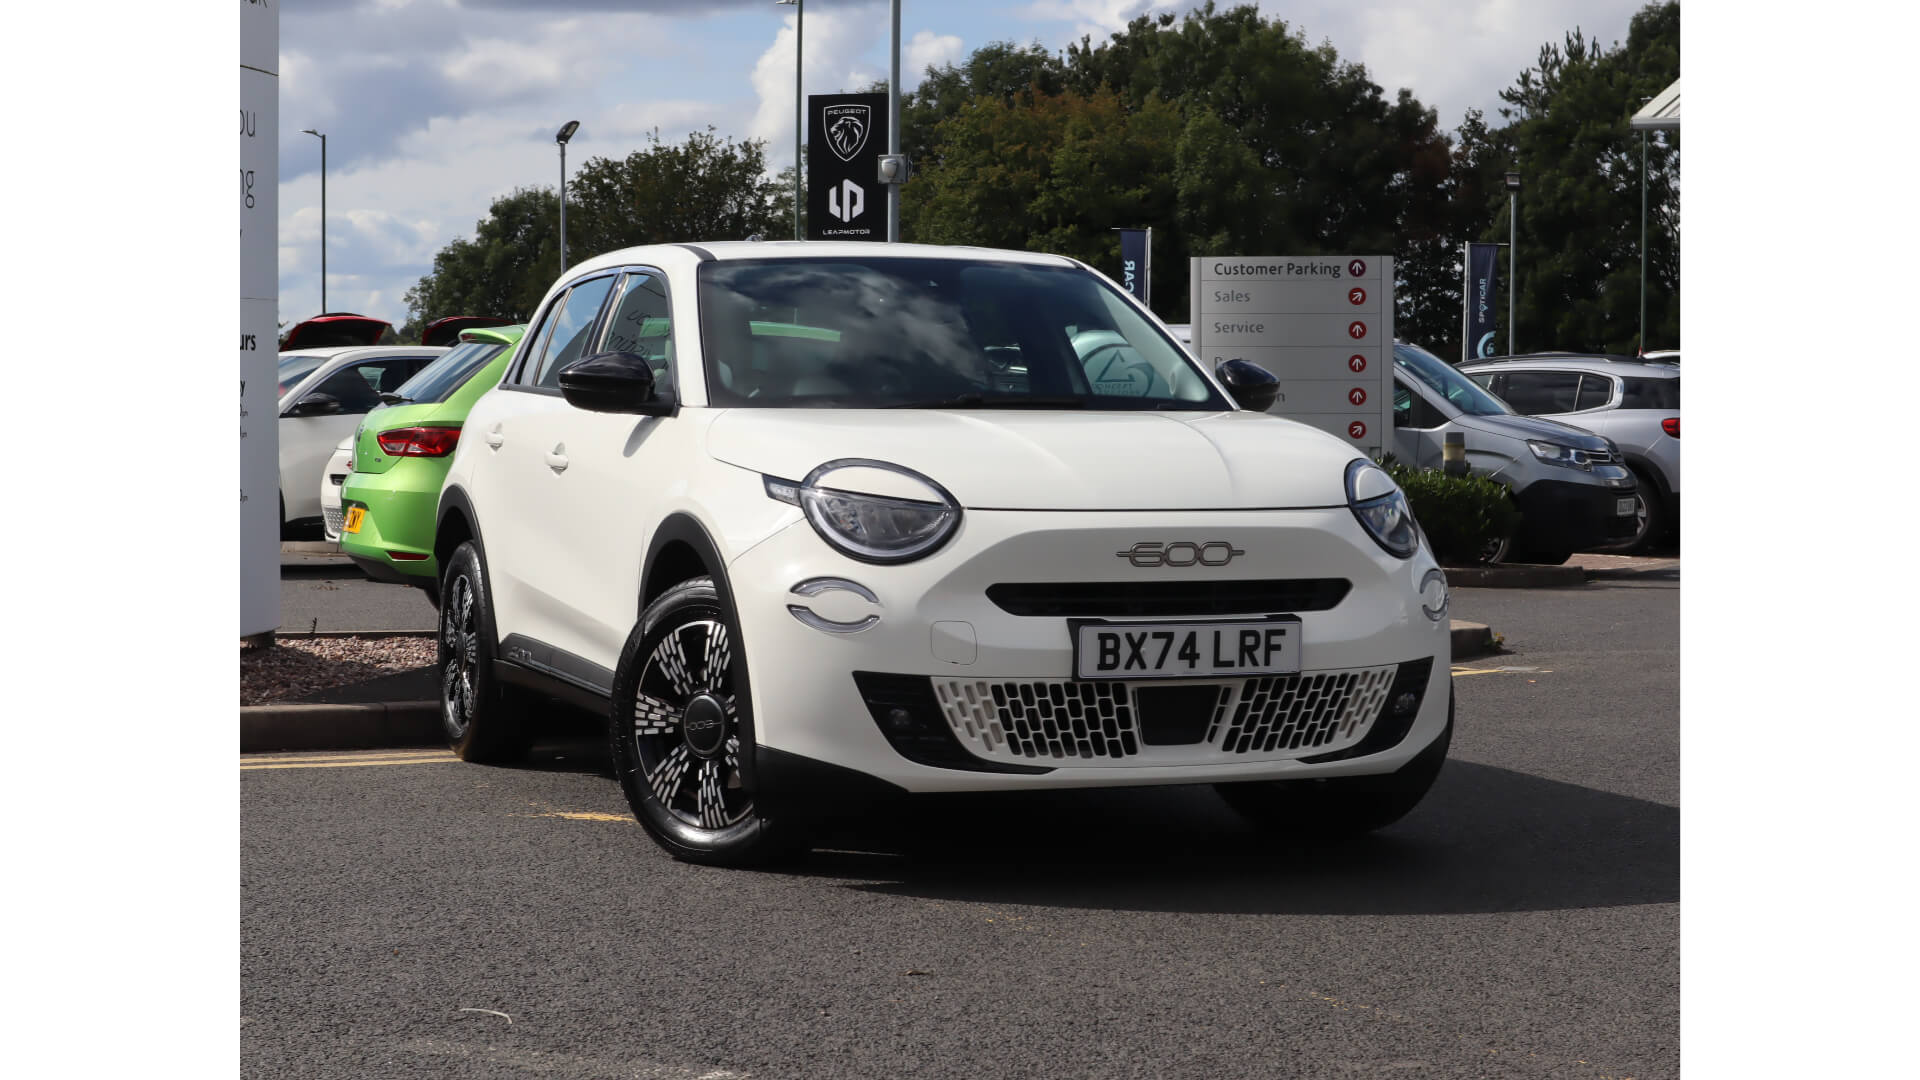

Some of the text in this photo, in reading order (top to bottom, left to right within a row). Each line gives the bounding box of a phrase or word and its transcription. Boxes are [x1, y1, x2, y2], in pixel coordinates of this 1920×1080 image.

[1214, 262, 1341, 278] Customer Parking
[1214, 290, 1251, 303] Sales
[1214, 321, 1265, 333] Service
[1116, 541, 1245, 567] 600
[1097, 629, 1286, 671] BX74 LRF
